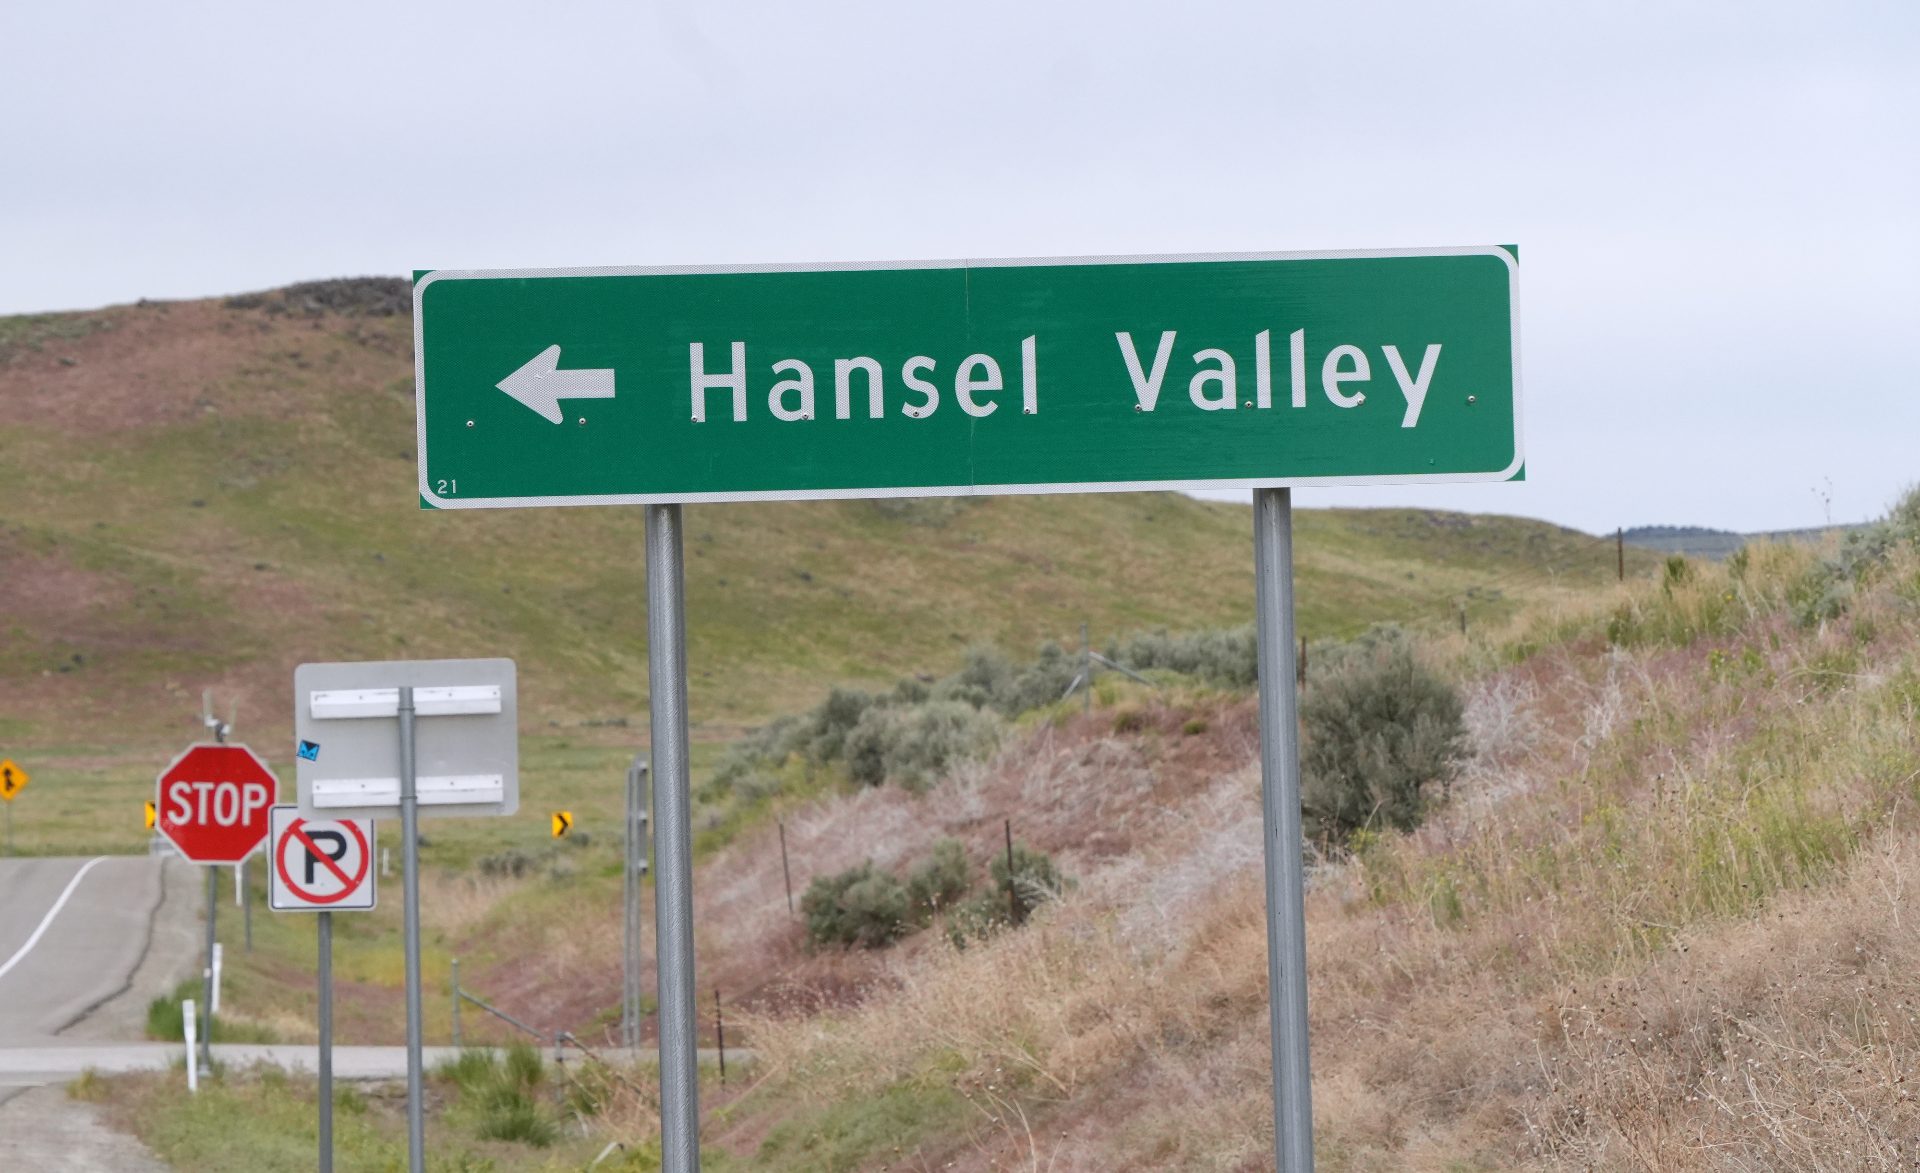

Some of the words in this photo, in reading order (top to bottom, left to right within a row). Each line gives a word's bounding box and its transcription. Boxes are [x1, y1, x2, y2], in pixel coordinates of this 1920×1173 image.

[689, 334, 1037, 422] Hansel
[1115, 328, 1443, 428] Valley
[437, 479, 457, 494] 21
[168, 781, 268, 827] STOP
[305, 831, 347, 884] P
